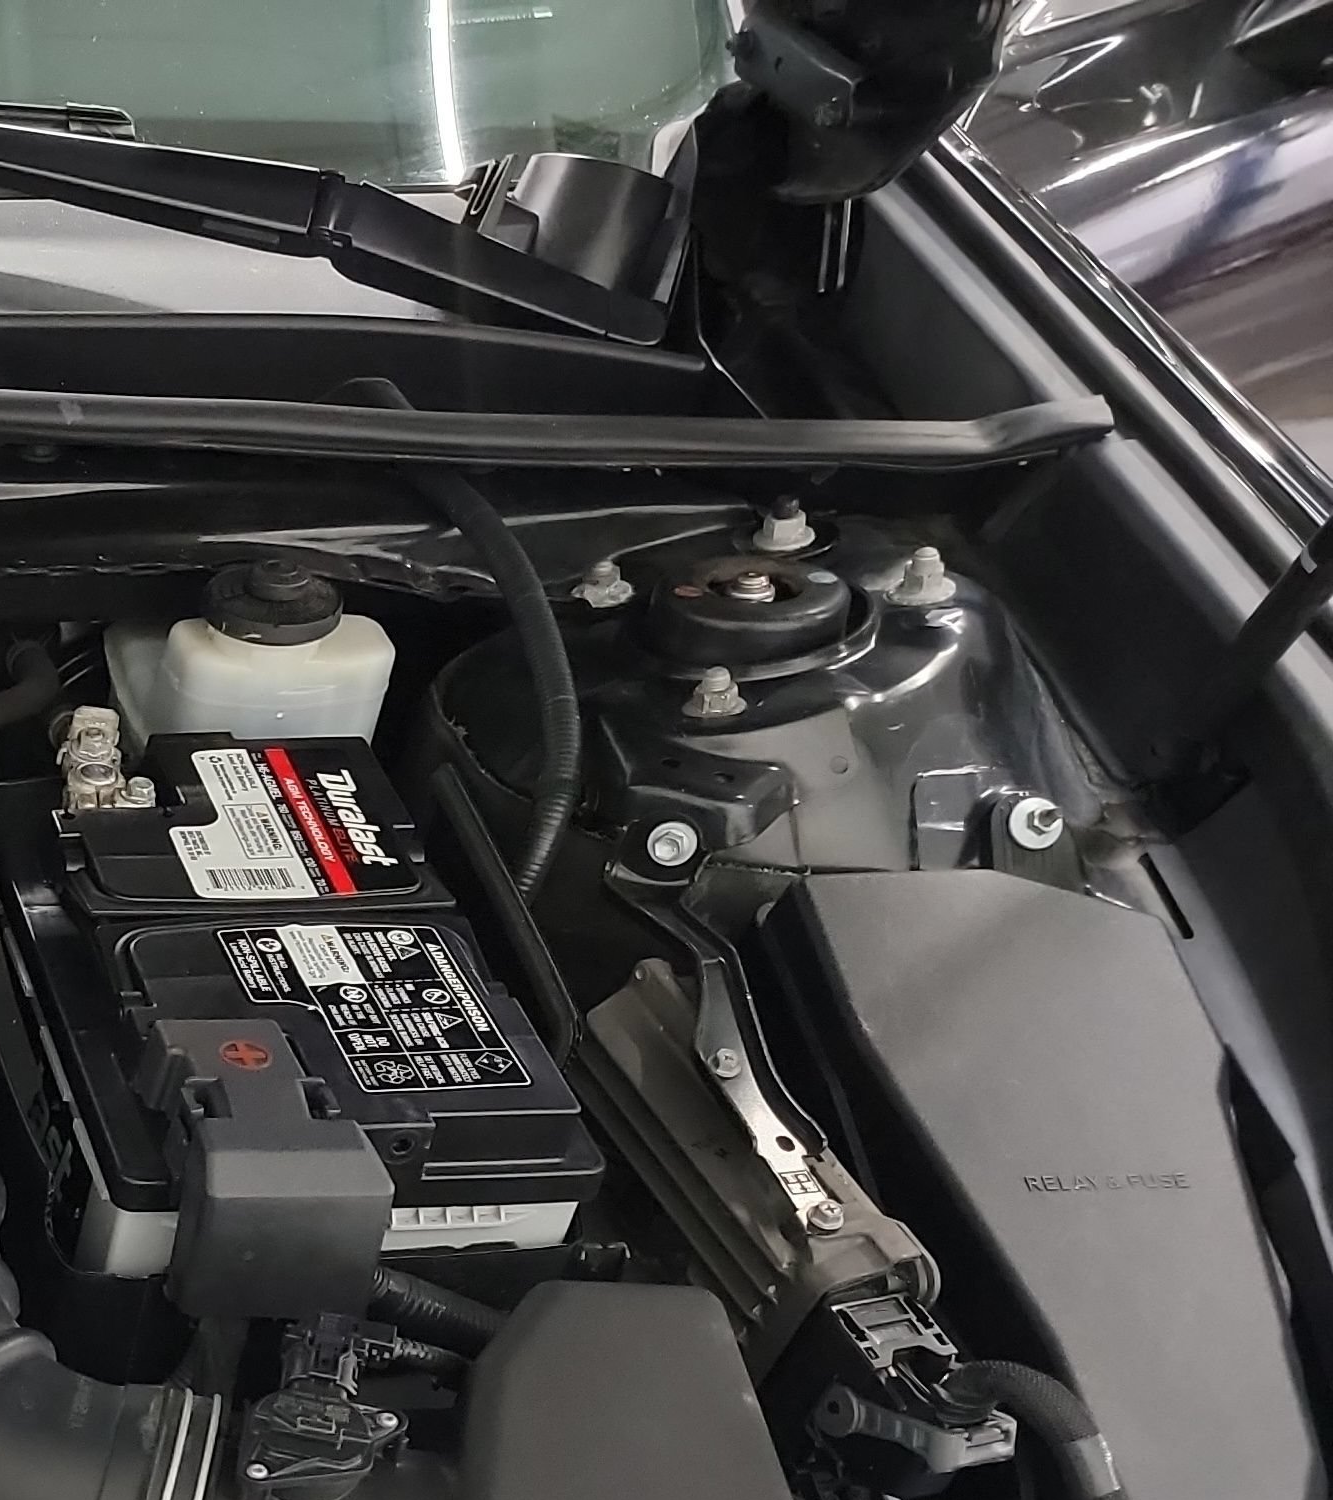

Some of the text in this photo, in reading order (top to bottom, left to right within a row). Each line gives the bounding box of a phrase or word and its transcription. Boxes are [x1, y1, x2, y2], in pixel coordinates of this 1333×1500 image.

[281, 777, 303, 798] AGM
[293, 800, 337, 861] TECHNOLOGY
[303, 779, 340, 826] PLATINUM
[312, 768, 400, 866] Duralast
[235, 938, 272, 992] NON-SPILLABLE
[429, 951, 491, 1031] DANGER/POISON
[359, 1033, 379, 1049] NOT
[1023, 1174, 1099, 1193] RELAY
[1126, 1172, 1191, 1190] FUSE
